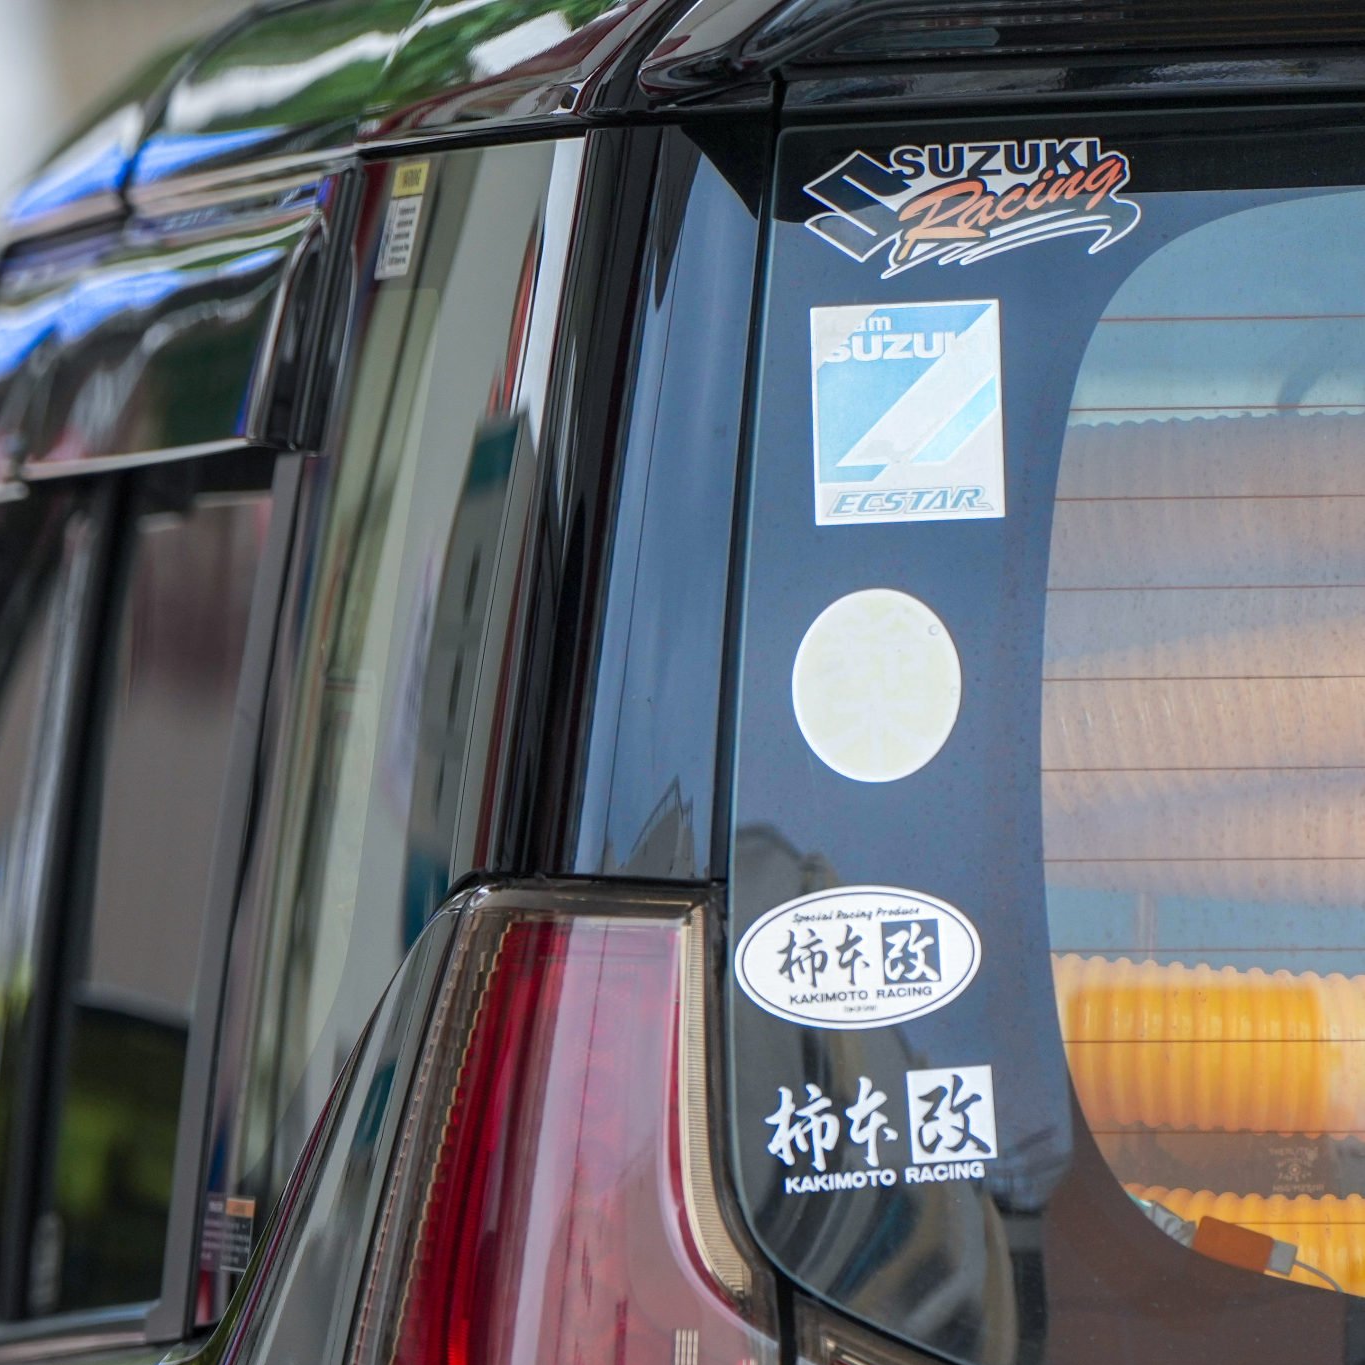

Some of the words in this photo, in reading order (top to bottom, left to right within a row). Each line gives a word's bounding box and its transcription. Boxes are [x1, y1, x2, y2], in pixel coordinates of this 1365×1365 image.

[890, 138, 1100, 180] SUZUKI
[896, 156, 1126, 260] Racing
[830, 485, 994, 516] ECSTAR
[835, 909, 873, 921] Racing
[789, 990, 869, 1005] KAKIMOTO
[876, 985, 933, 999] RACING
[784, 1168, 897, 1195] KAKIMOTO
[904, 1160, 986, 1185] RACING
